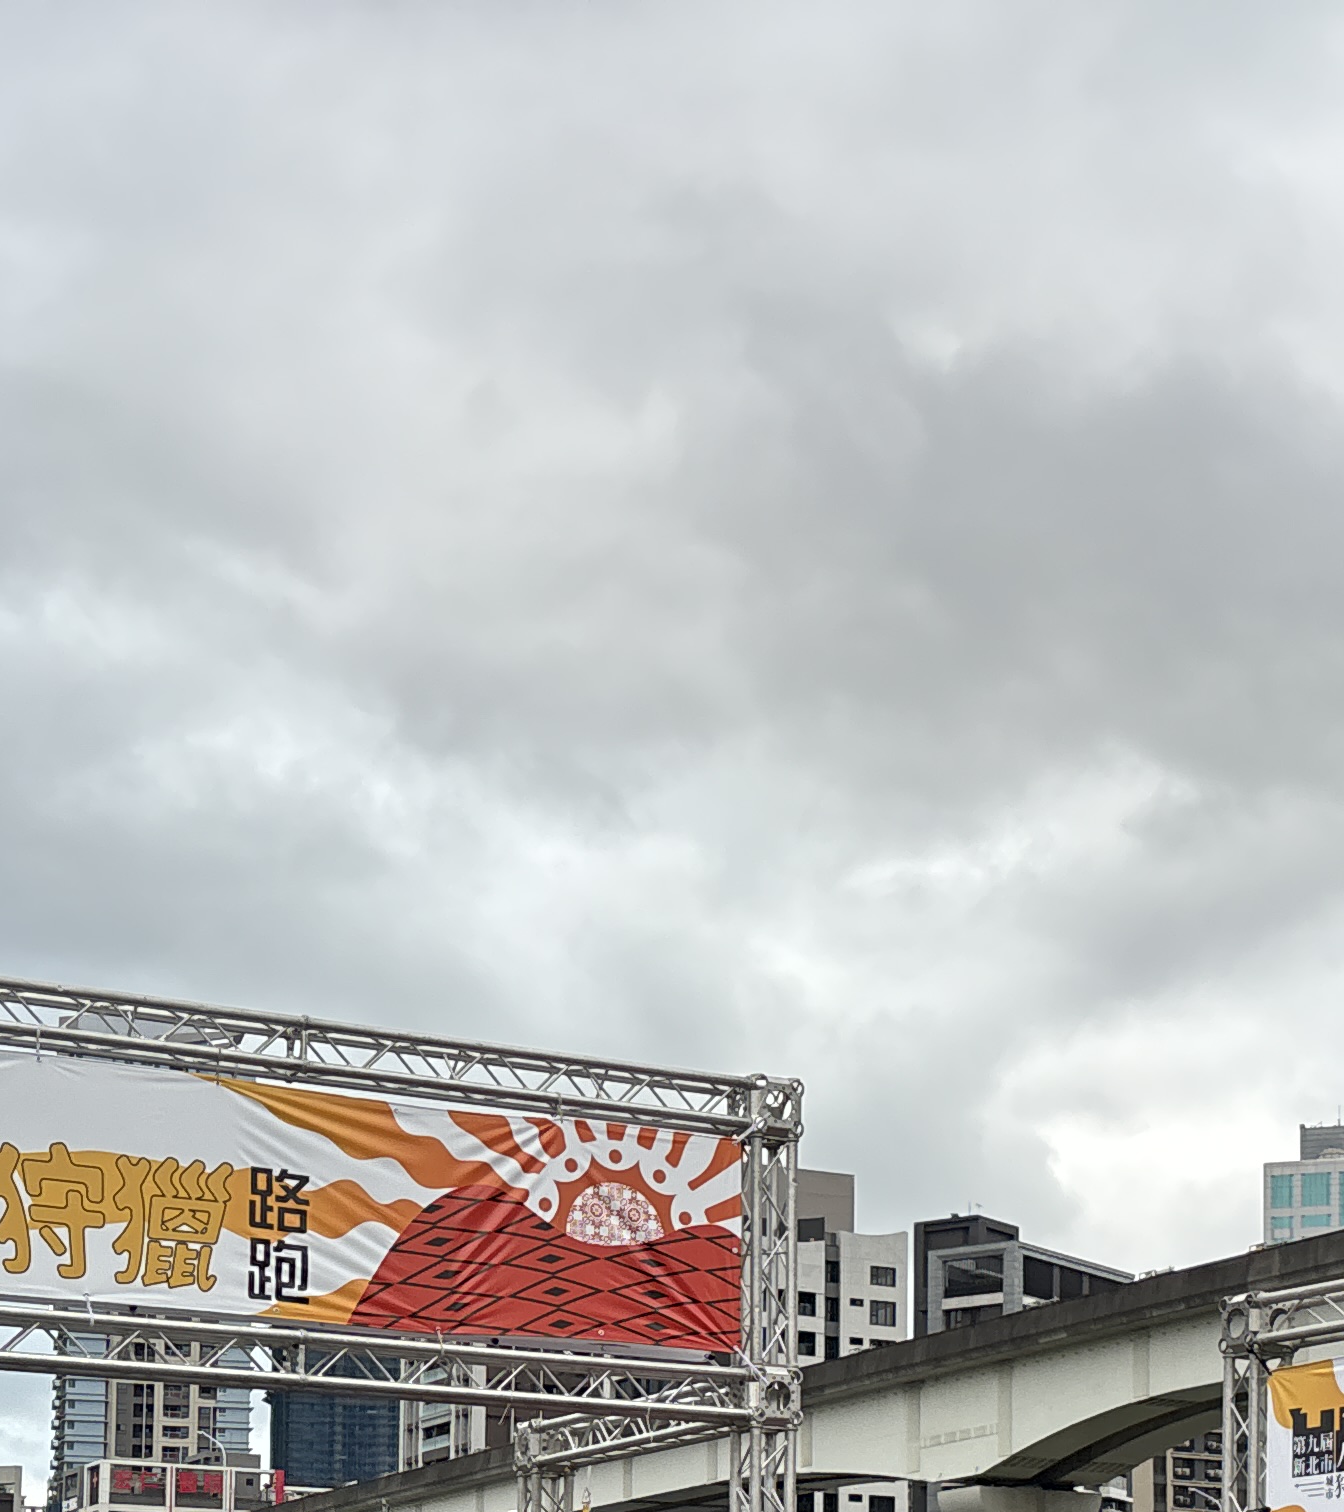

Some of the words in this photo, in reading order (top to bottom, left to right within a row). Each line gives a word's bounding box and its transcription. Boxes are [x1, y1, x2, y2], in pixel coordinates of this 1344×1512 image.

[248, 1166, 311, 1305] 路跑
[1293, 1431, 1334, 1455] 第九屆
[1293, 1453, 1334, 1476] 新北市
